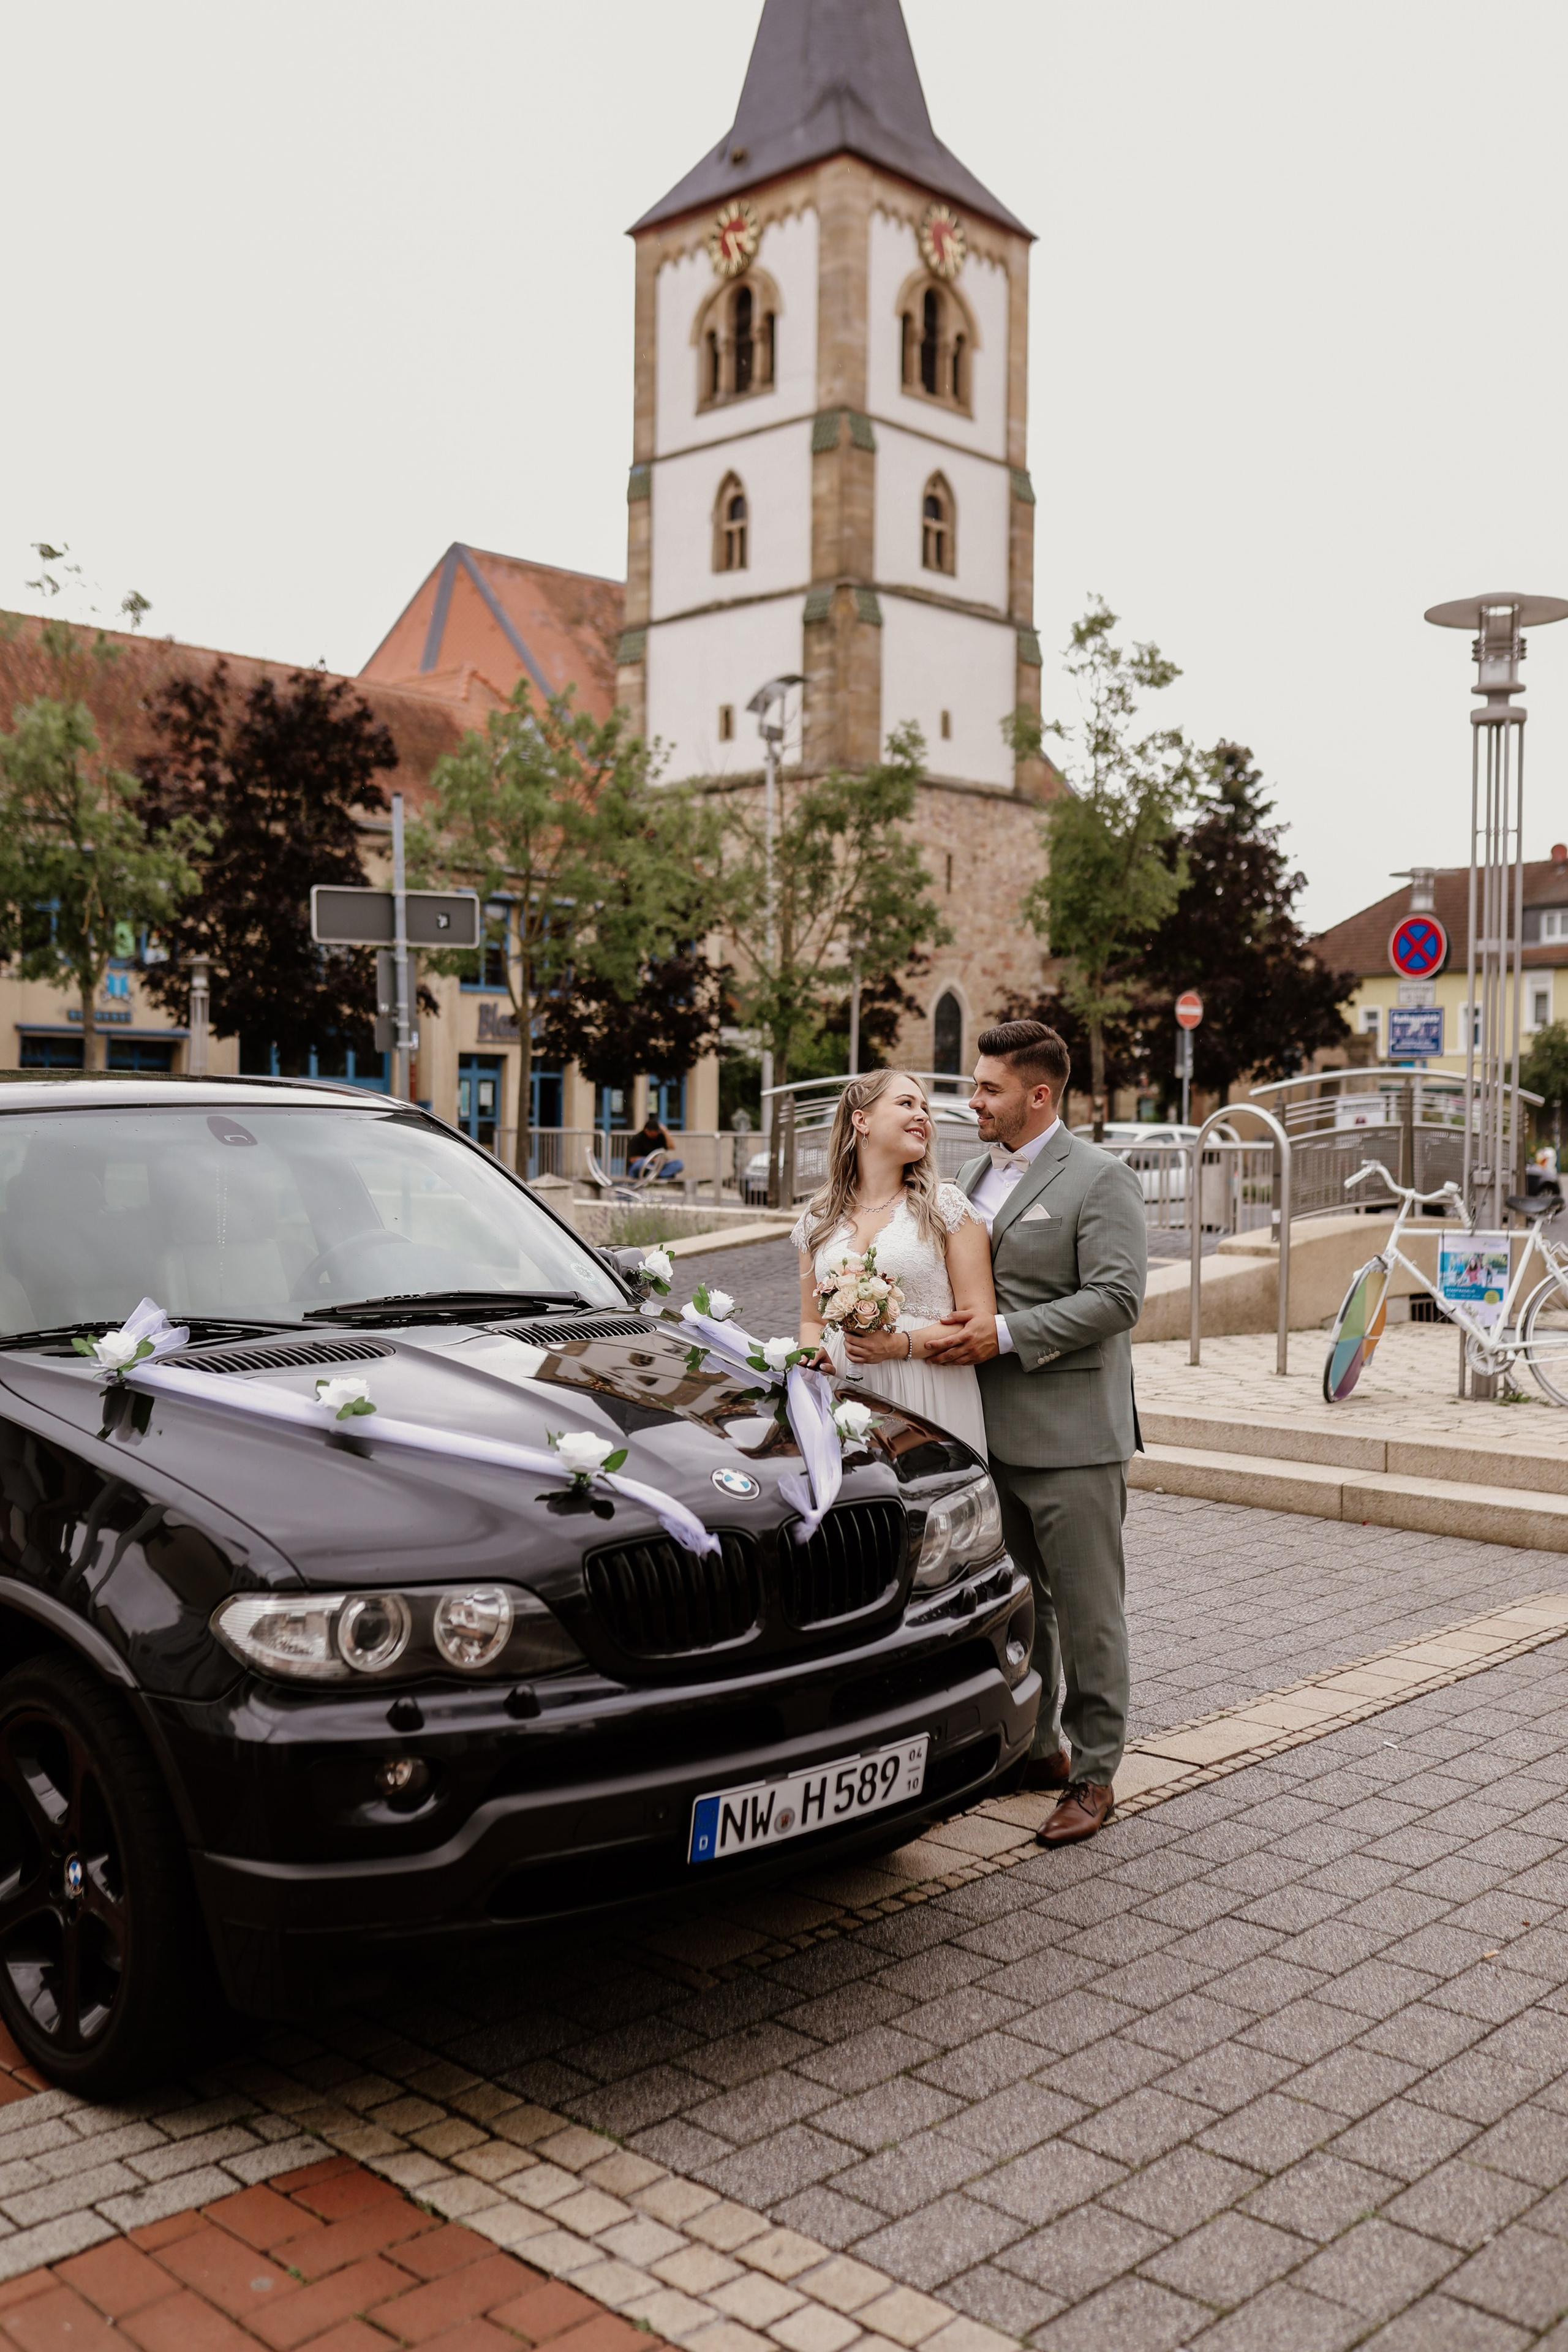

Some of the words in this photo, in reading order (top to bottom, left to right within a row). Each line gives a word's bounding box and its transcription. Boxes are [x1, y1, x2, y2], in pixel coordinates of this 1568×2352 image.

[910, 1747, 922, 1762] 04
[908, 1777, 919, 1792] 10
[720, 1790, 776, 1848] NW
[699, 1834, 709, 1852] D
